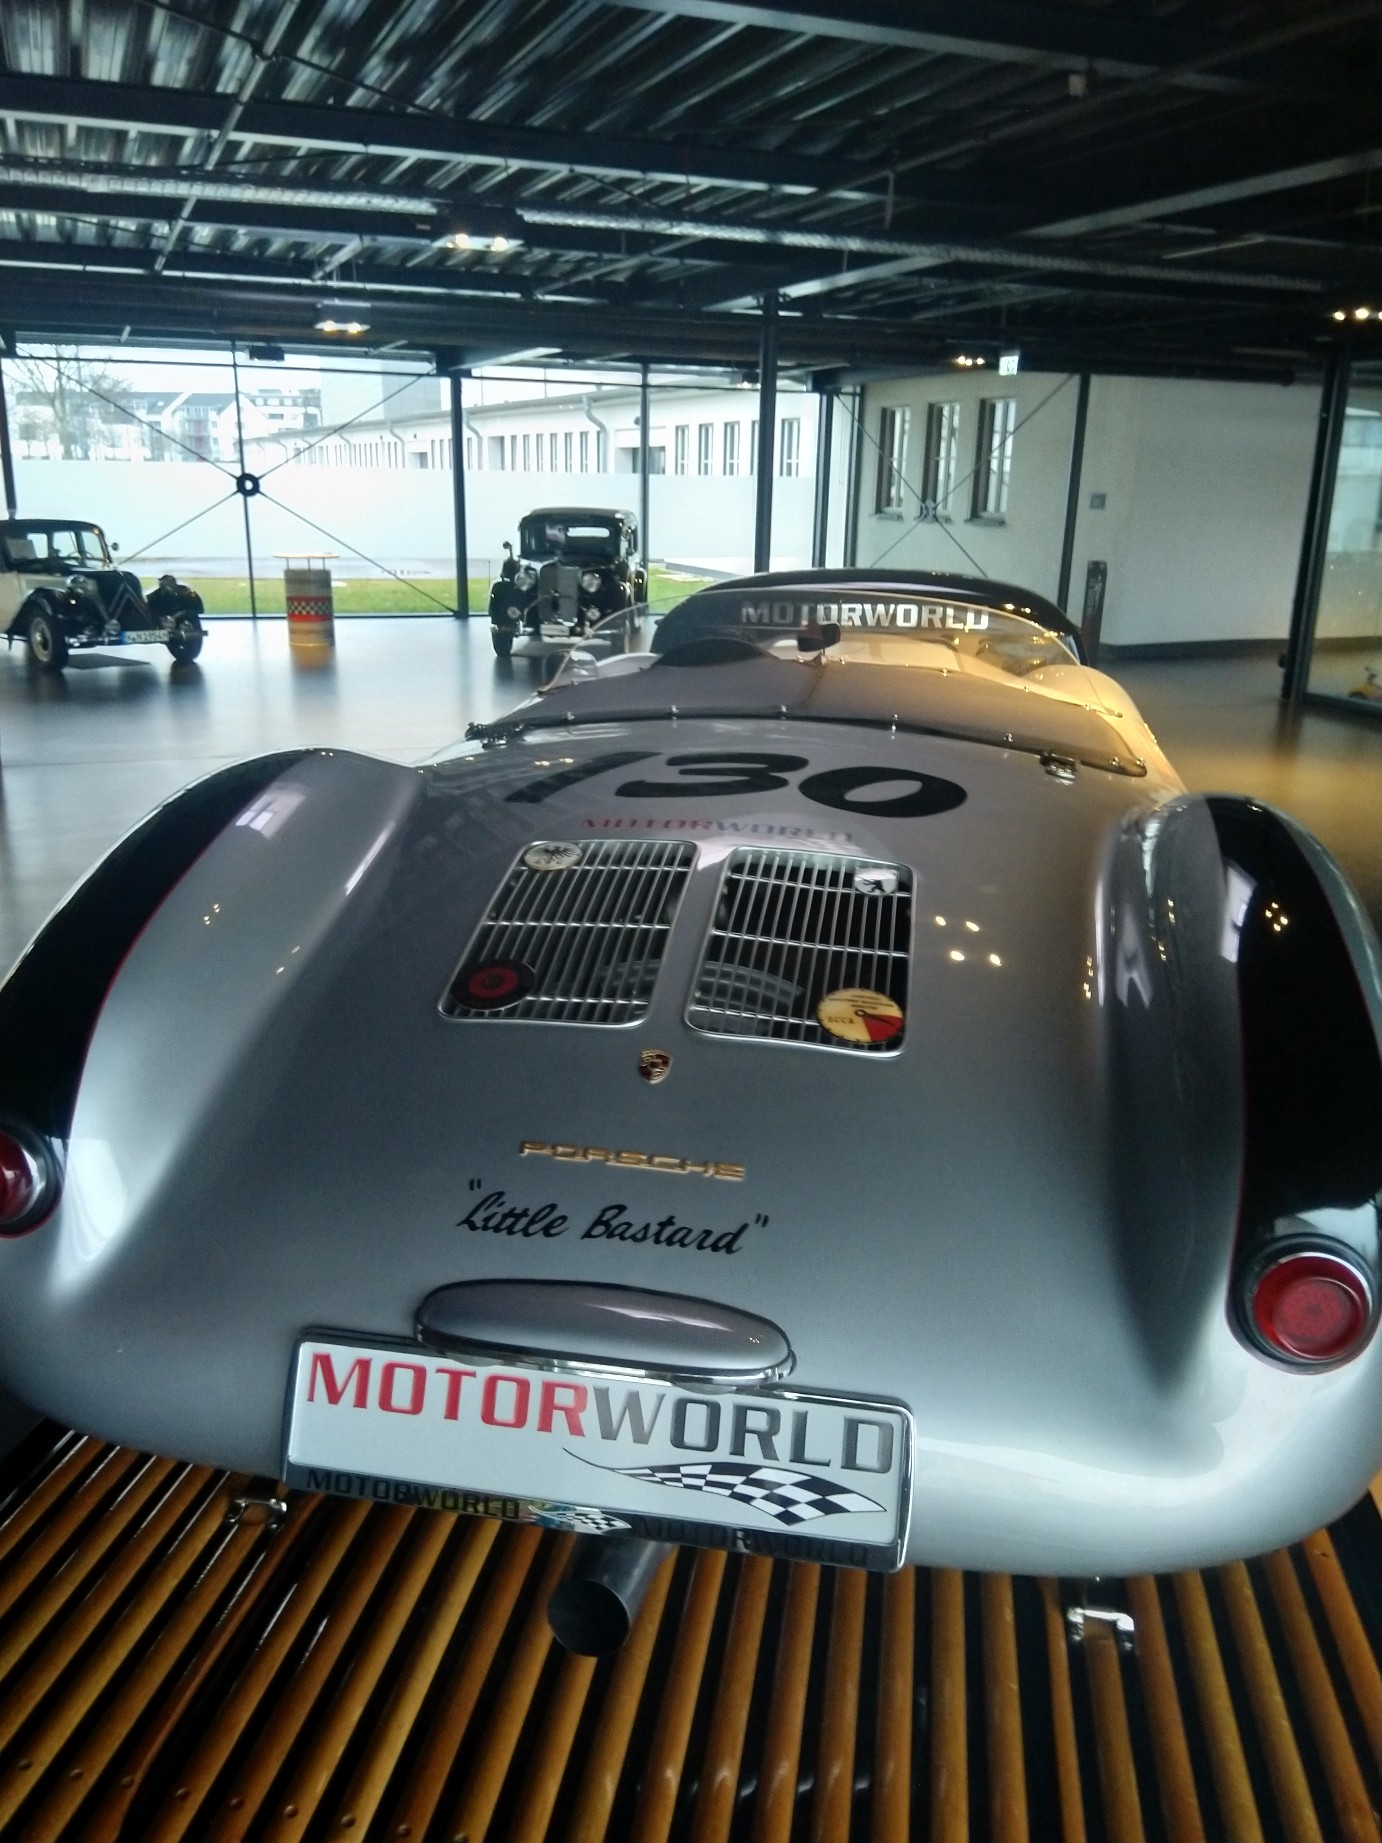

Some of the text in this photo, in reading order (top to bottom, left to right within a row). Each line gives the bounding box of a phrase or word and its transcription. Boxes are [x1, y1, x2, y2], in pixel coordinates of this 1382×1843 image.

[741, 601, 990, 630] MOTORWORLD
[505, 752, 968, 818] 130
[519, 1140, 746, 1182] PORSCHE
[307, 1468, 521, 1520] MOTORWORLD
